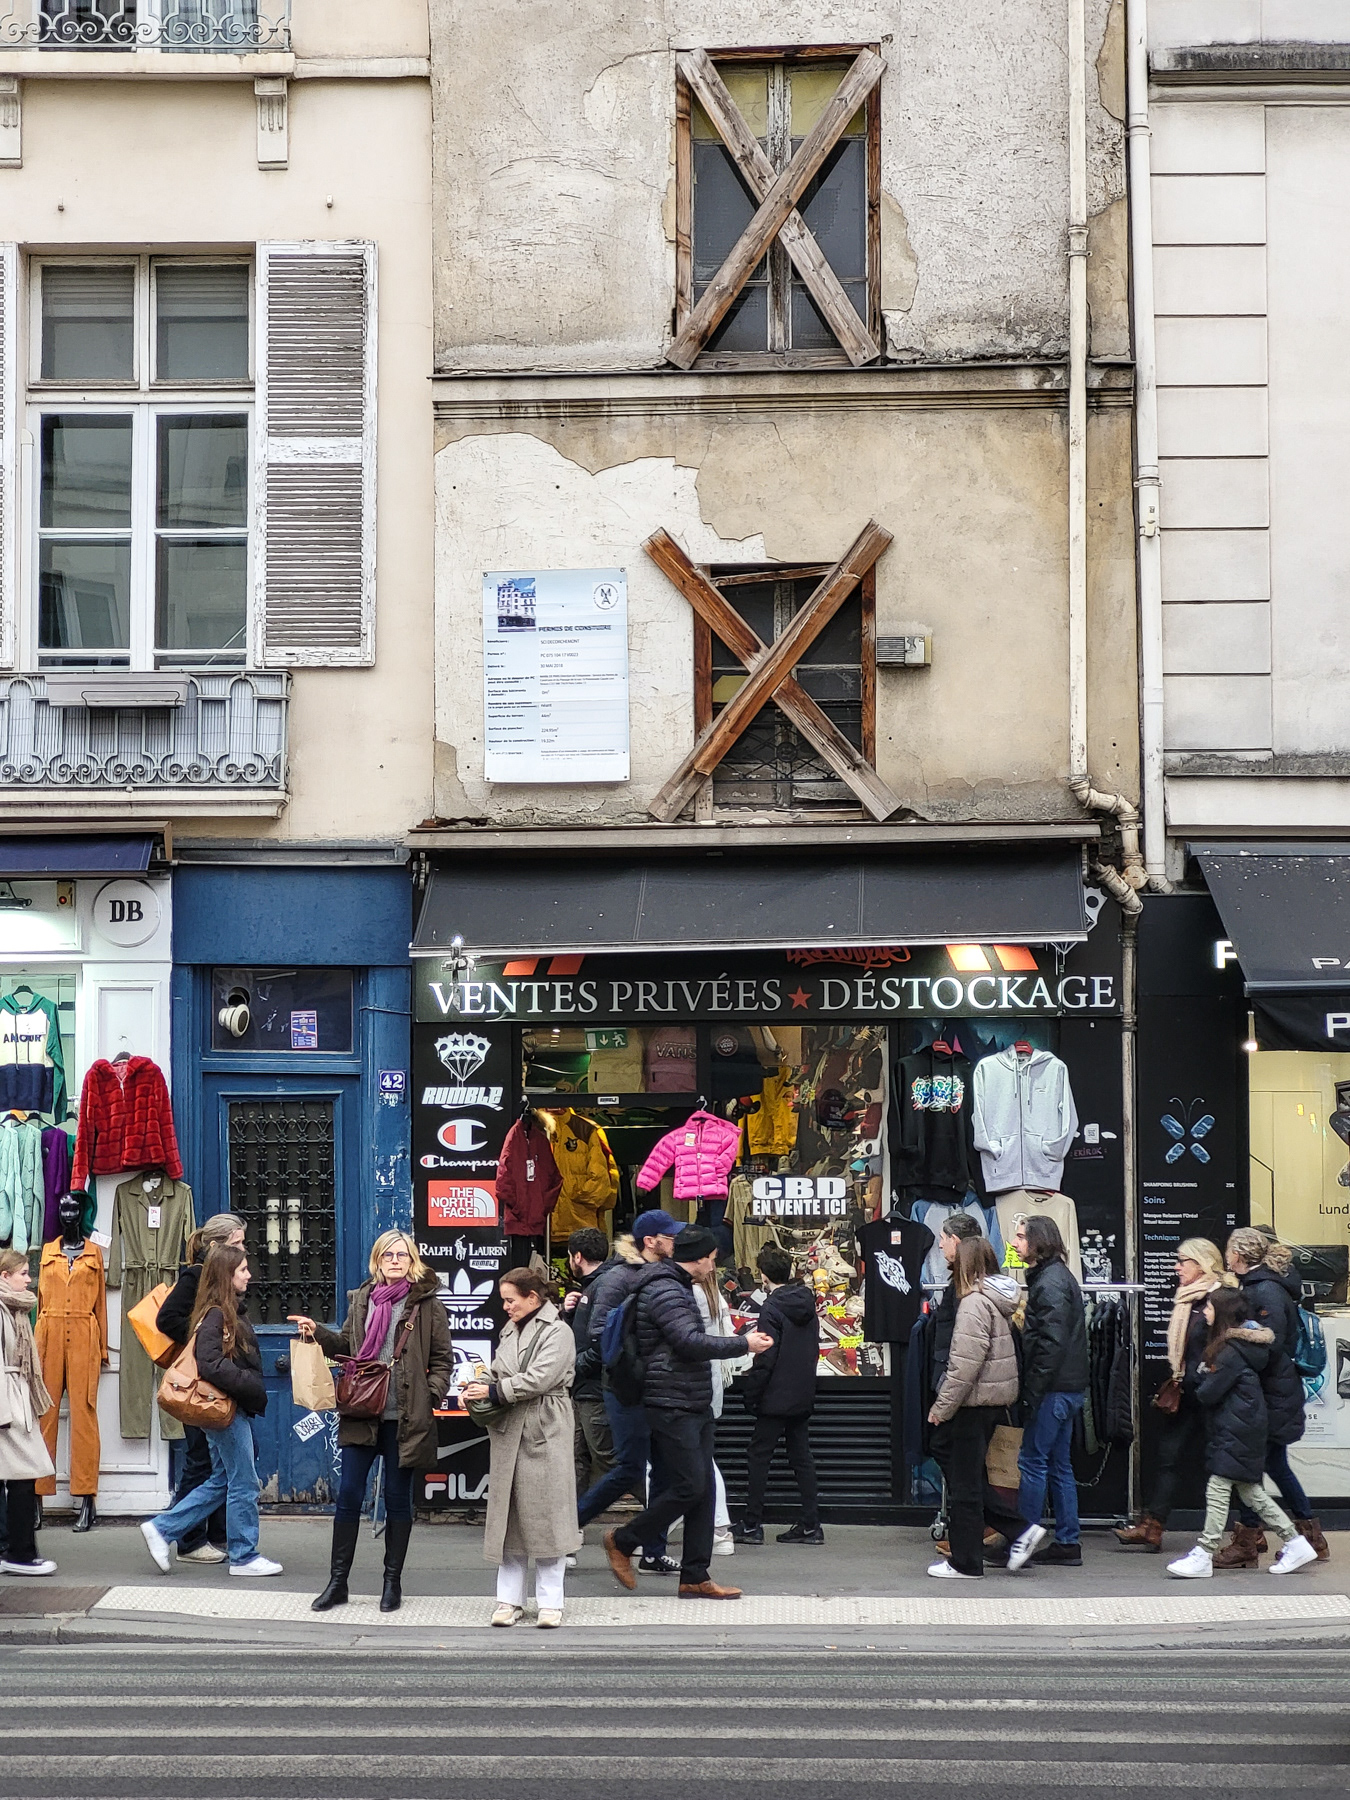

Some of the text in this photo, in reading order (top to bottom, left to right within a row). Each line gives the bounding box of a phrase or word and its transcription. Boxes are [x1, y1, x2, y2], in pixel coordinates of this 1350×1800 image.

[109, 900, 144, 923] DB
[428, 970, 1117, 1014] VENTES PRIVÉES DÉSTOCKAGE
[381, 1074, 403, 1089] 42
[421, 1086, 504, 1108] RUMBLE
[449, 1187, 474, 1197] THE
[752, 1177, 847, 1200] CBD
[430, 1197, 474, 1208] NORTH
[753, 1199, 847, 1216] EN VENTE ICI
[1143, 1196, 1166, 1204] Soins
[1143, 1234, 1181, 1242] Techniques
[419, 1242, 507, 1256] RALPH LAUREN
[448, 1313, 495, 1330] didas
